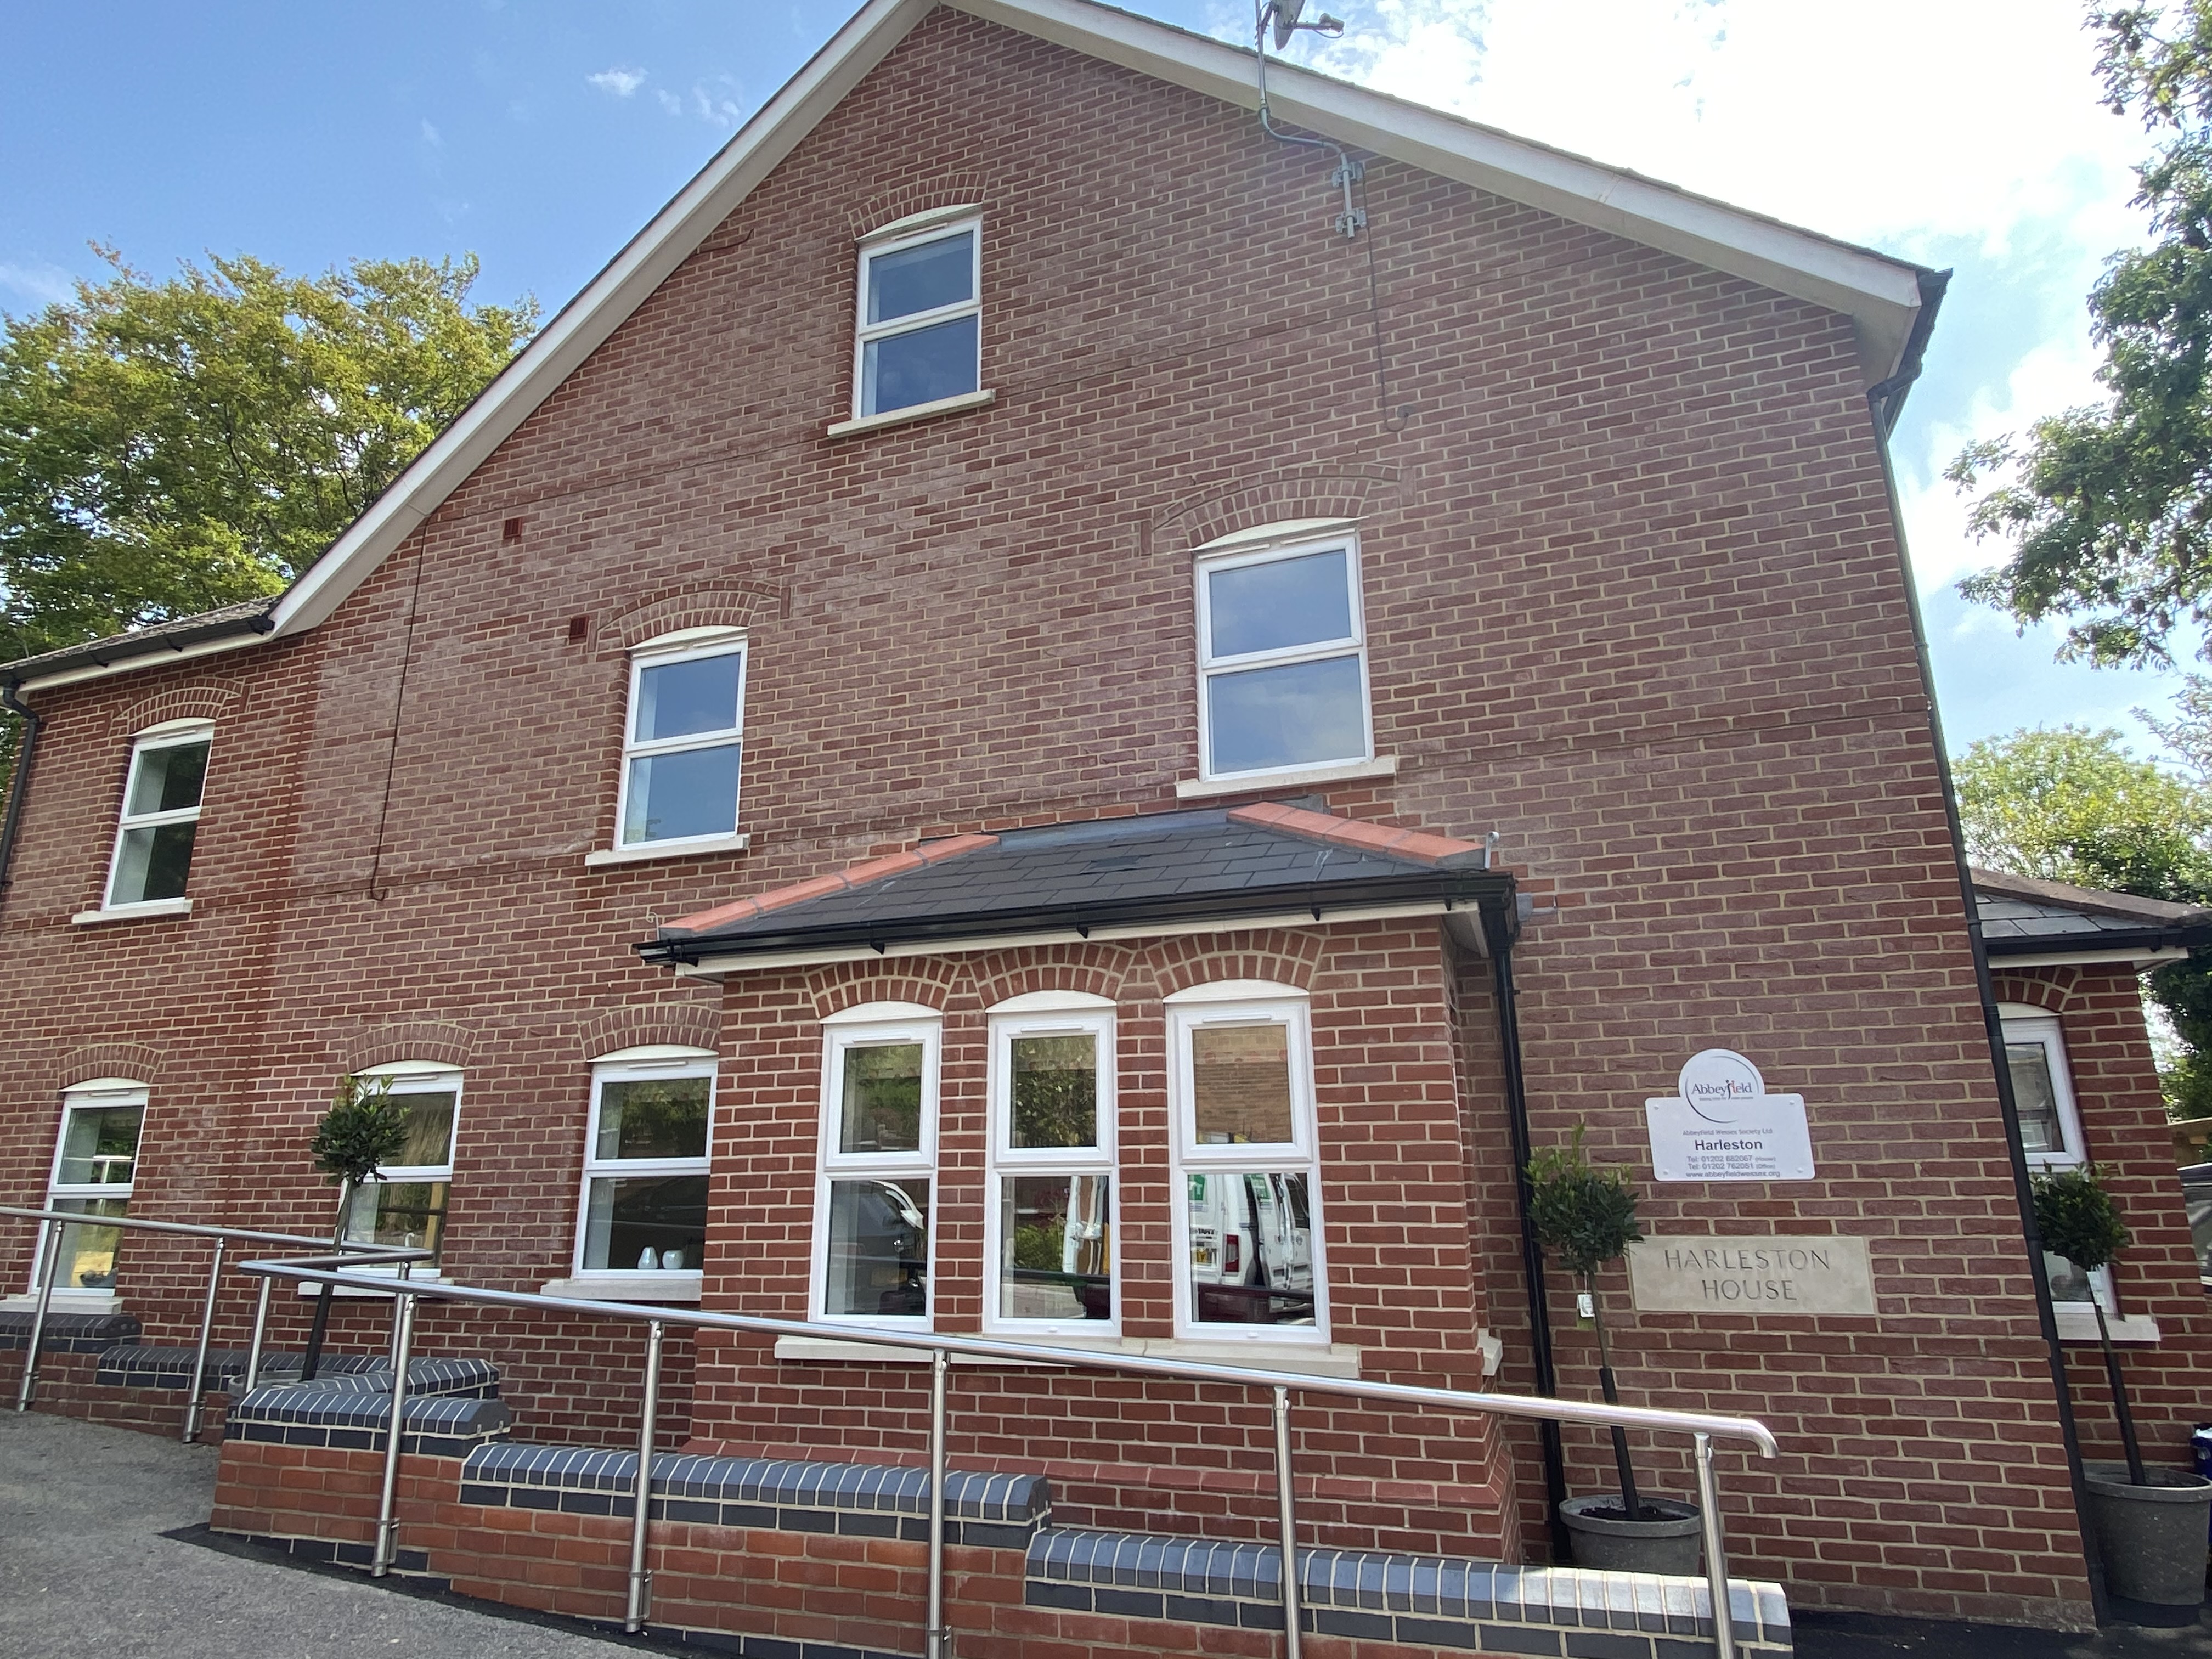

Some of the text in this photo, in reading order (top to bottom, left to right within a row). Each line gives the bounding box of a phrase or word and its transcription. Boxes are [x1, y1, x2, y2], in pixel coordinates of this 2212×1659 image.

[1691, 1080, 1752, 1100] Abbeyfield
[1695, 1139, 1763, 1150] Harleston
[1664, 1249, 1830, 1271] HARLESTON
[1702, 1279, 1797, 1301] HOUSE
